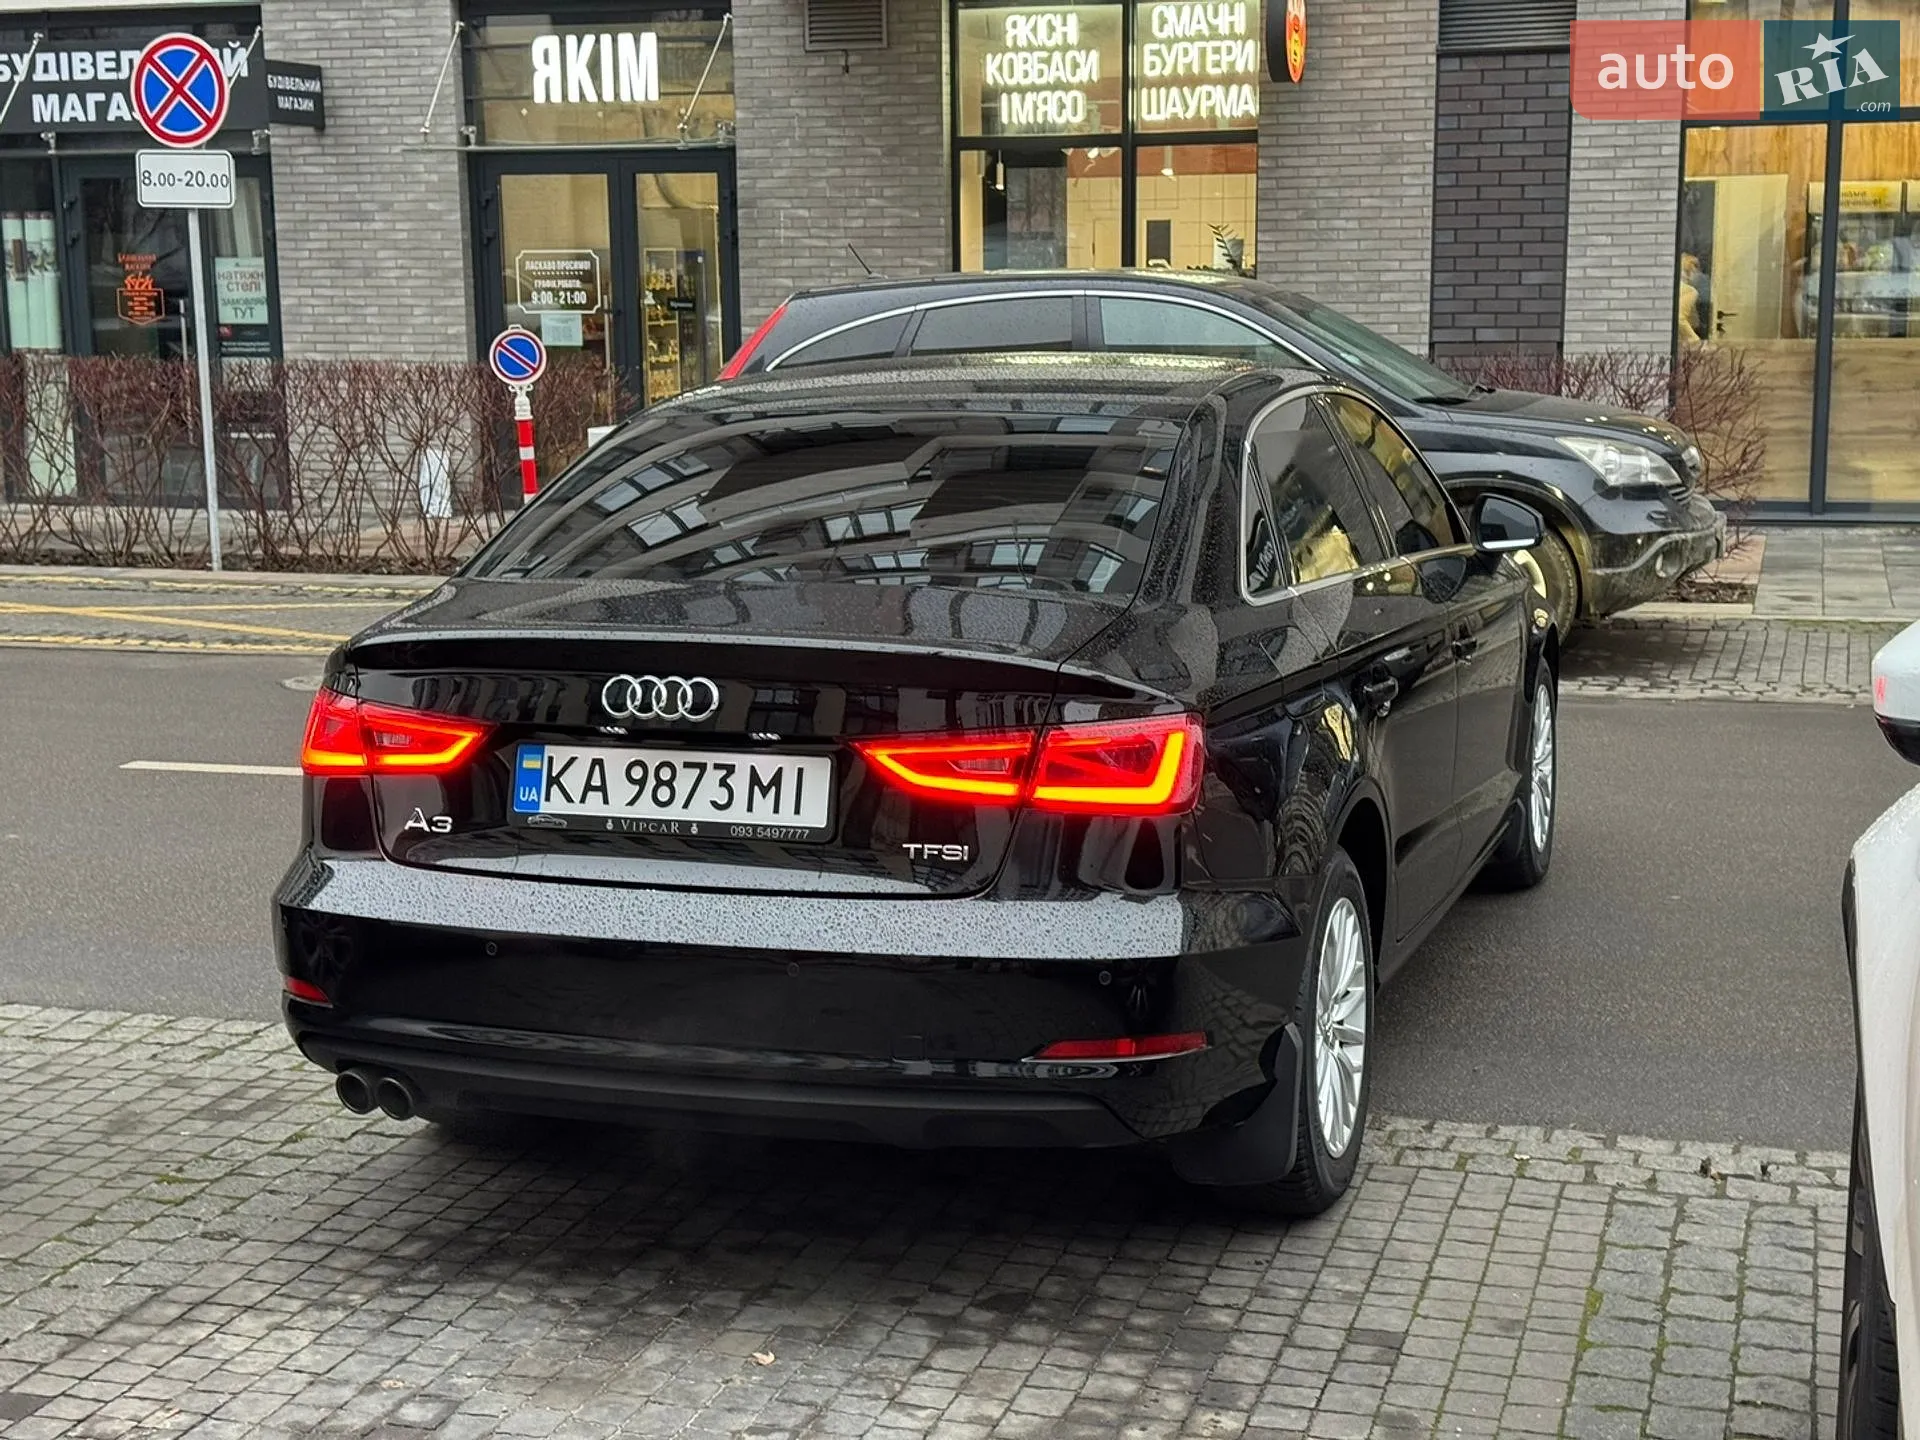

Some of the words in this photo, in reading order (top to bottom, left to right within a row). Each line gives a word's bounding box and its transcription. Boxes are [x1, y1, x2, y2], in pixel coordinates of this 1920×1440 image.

[1005, 12, 1079, 48] ЯКІСНІ
[1151, 3, 1246, 39] СМАЧНІ
[0, 40, 248, 82] БУДІВЕЛЙ
[531, 31, 660, 104] ЯКІМ
[986, 49, 1099, 86] КОВБАСИ
[1143, 40, 1256, 76] БУРГЕРИ
[32, 92, 140, 123] МАГА
[1001, 92, 1010, 125] І
[1141, 83, 1256, 120] ШАУРМА
[142, 170, 230, 188] 8.00-20.00
[519, 786, 538, 802] UA
[545, 755, 610, 806] KA
[624, 759, 736, 812] 9873
[746, 764, 805, 816] MI
[404, 807, 453, 833] A3
[730, 825, 753, 838] 093
[757, 827, 810, 840] 5497777
[902, 843, 969, 861] TFSI
